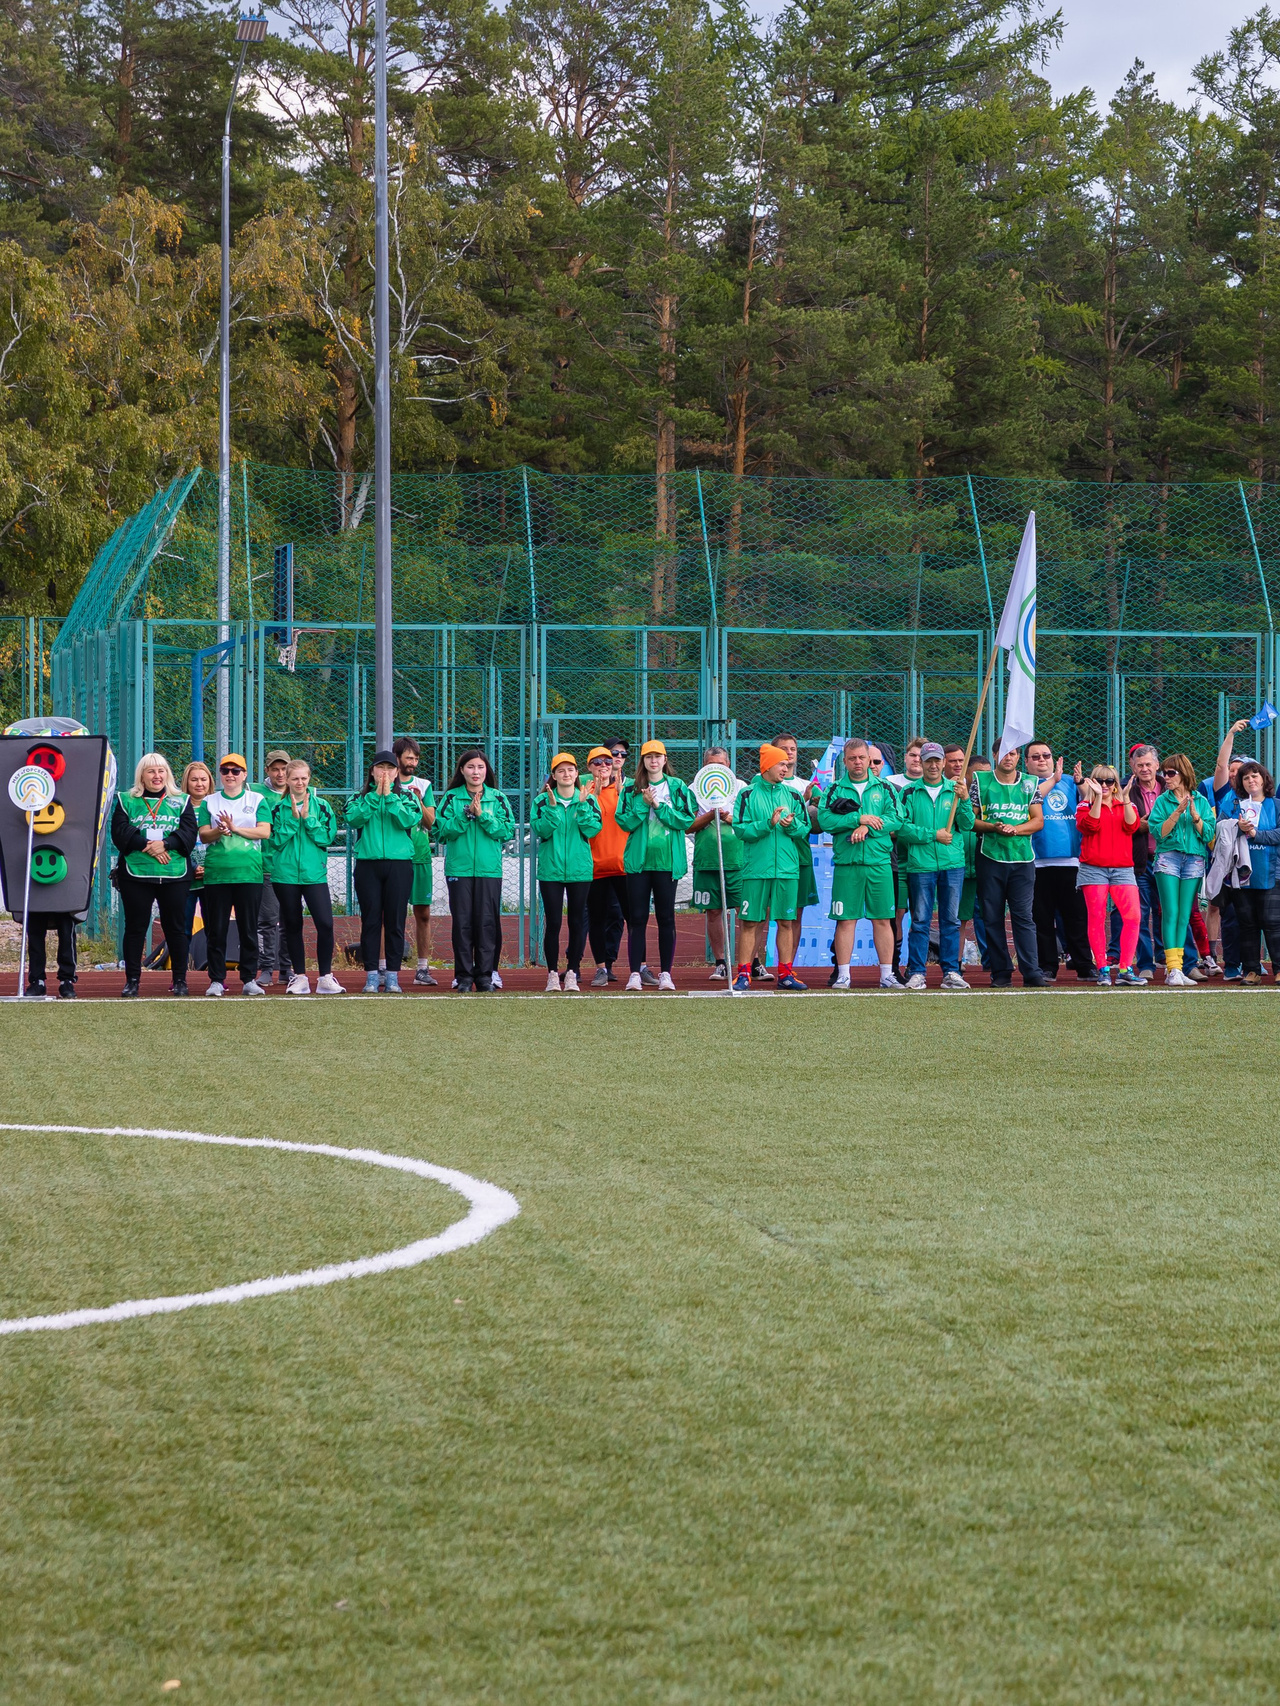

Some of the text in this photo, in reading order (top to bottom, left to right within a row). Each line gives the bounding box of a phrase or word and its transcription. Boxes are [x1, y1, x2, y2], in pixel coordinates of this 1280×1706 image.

[986, 803, 1029, 811] НА БЛАГ
[987, 811, 1028, 821] ГОРОДА
[741, 900, 749, 915] 2
[832, 900, 843, 916] 10
